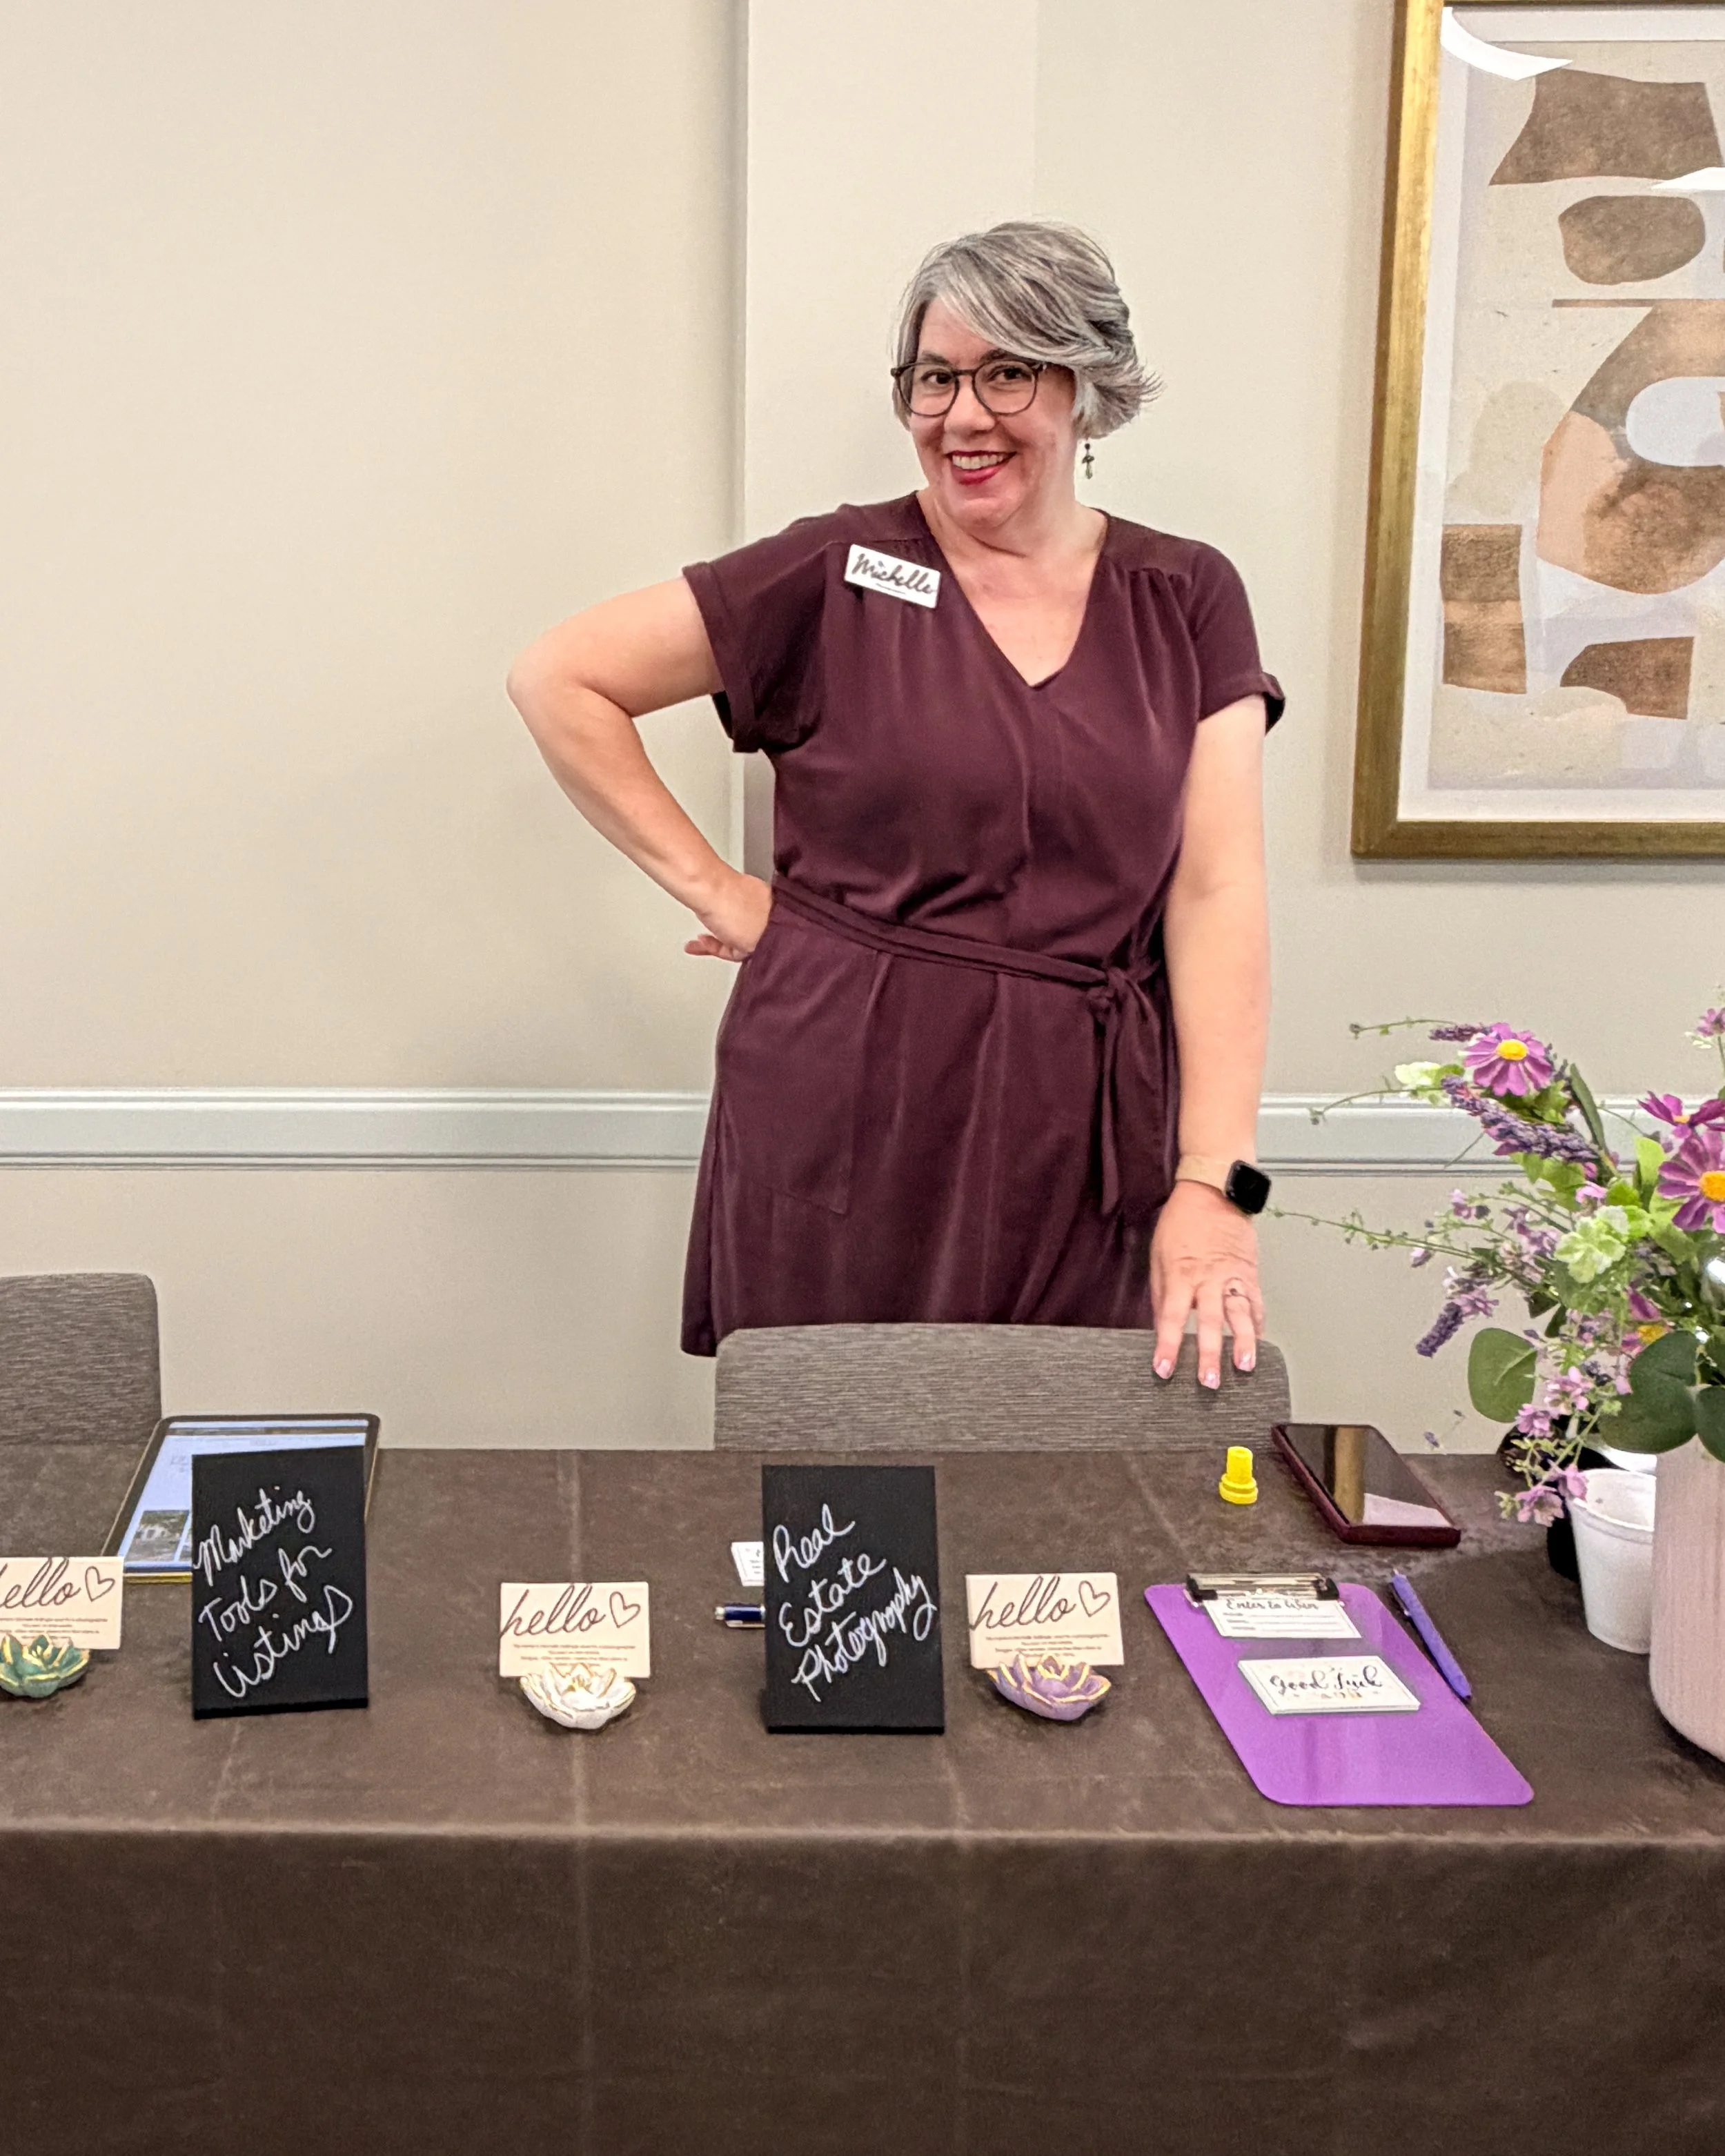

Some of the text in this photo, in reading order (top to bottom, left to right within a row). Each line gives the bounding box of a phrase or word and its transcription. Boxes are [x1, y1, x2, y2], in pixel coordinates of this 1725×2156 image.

[851, 553, 937, 594] Michelle
[193, 1485, 315, 1586] Marketing
[773, 1503, 856, 1583] Real
[0, 1557, 81, 1609] ello
[198, 1545, 333, 1641] Tools for
[500, 1584, 607, 1637] hello
[778, 1553, 887, 1648] Estate
[969, 1575, 1076, 1631] hello
[791, 1567, 938, 1702] Photography
